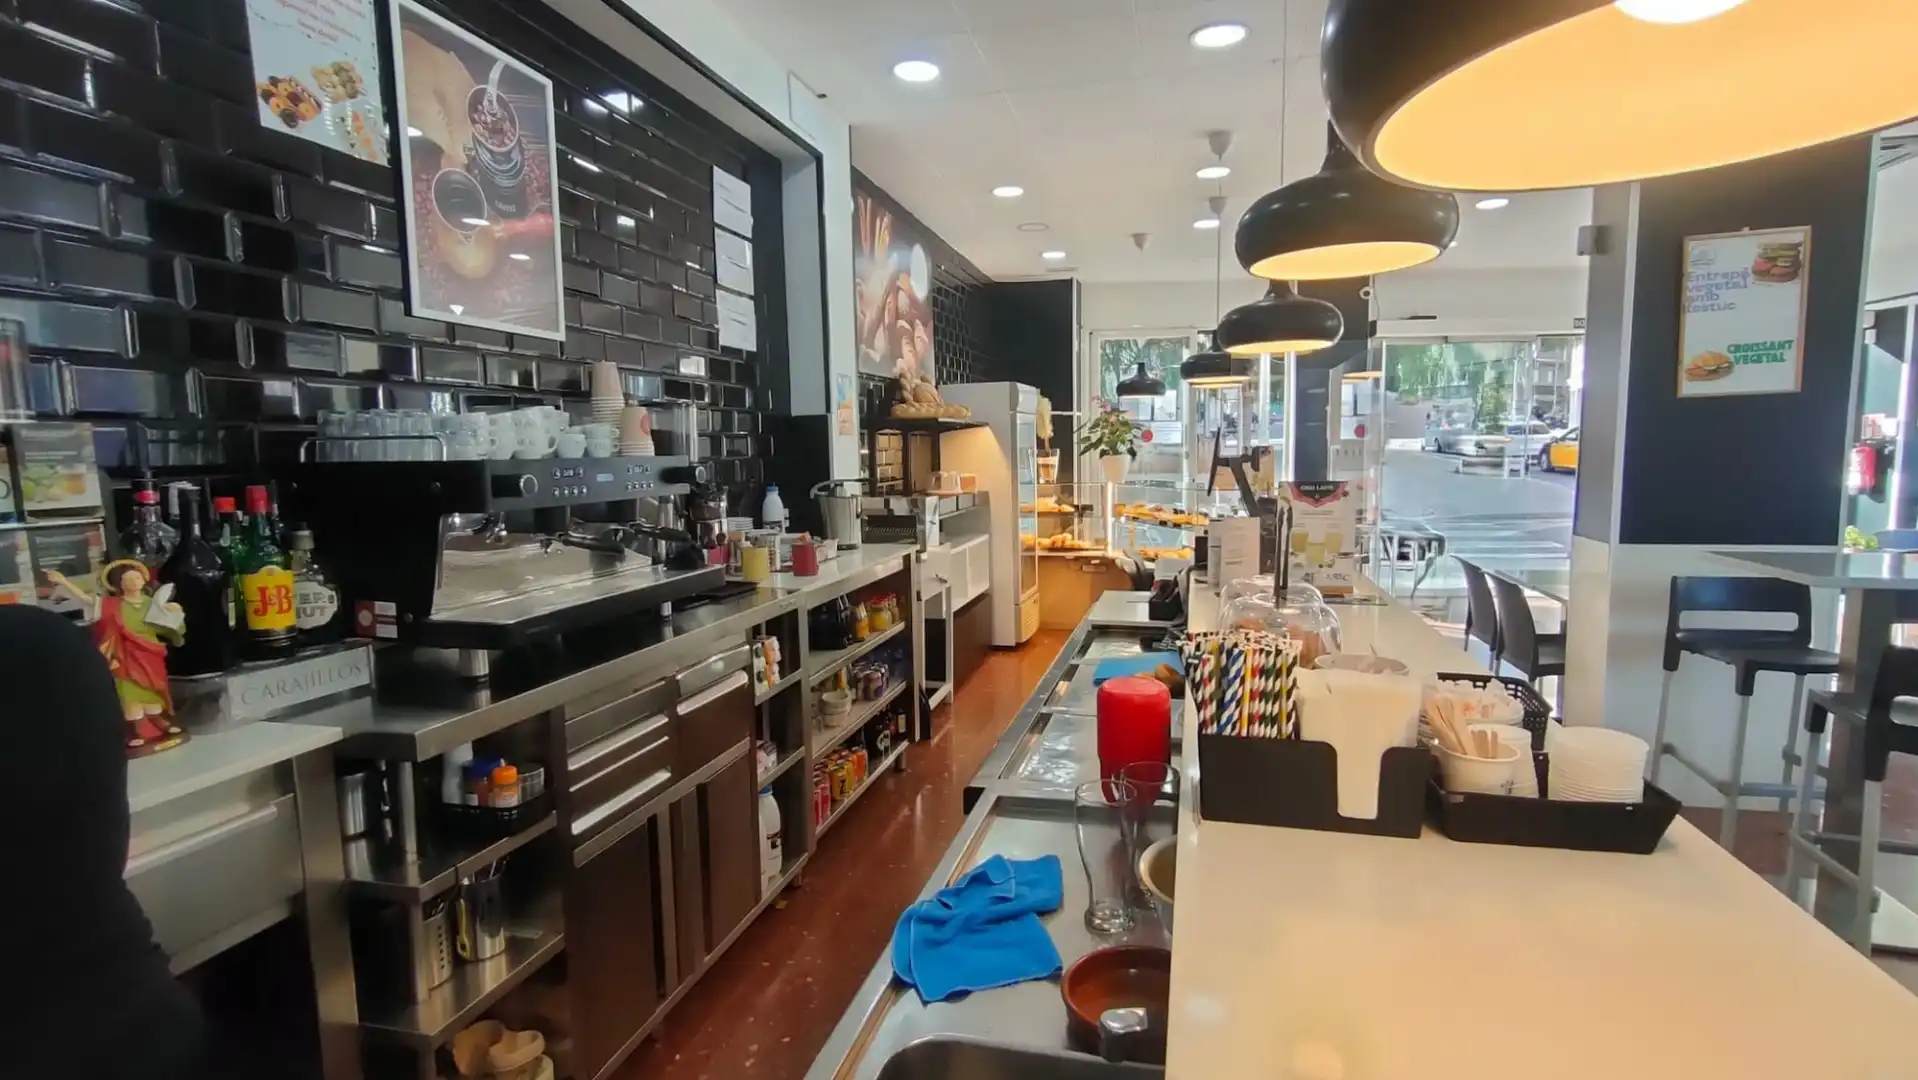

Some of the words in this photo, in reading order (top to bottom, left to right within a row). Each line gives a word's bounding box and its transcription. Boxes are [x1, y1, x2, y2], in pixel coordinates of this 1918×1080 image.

[1727, 340, 1795, 354] CROISSANT
[1734, 352, 1787, 365] VEGETAL
[253, 584, 293, 617] J&B
[241, 663, 362, 705] CARAJILLOS
